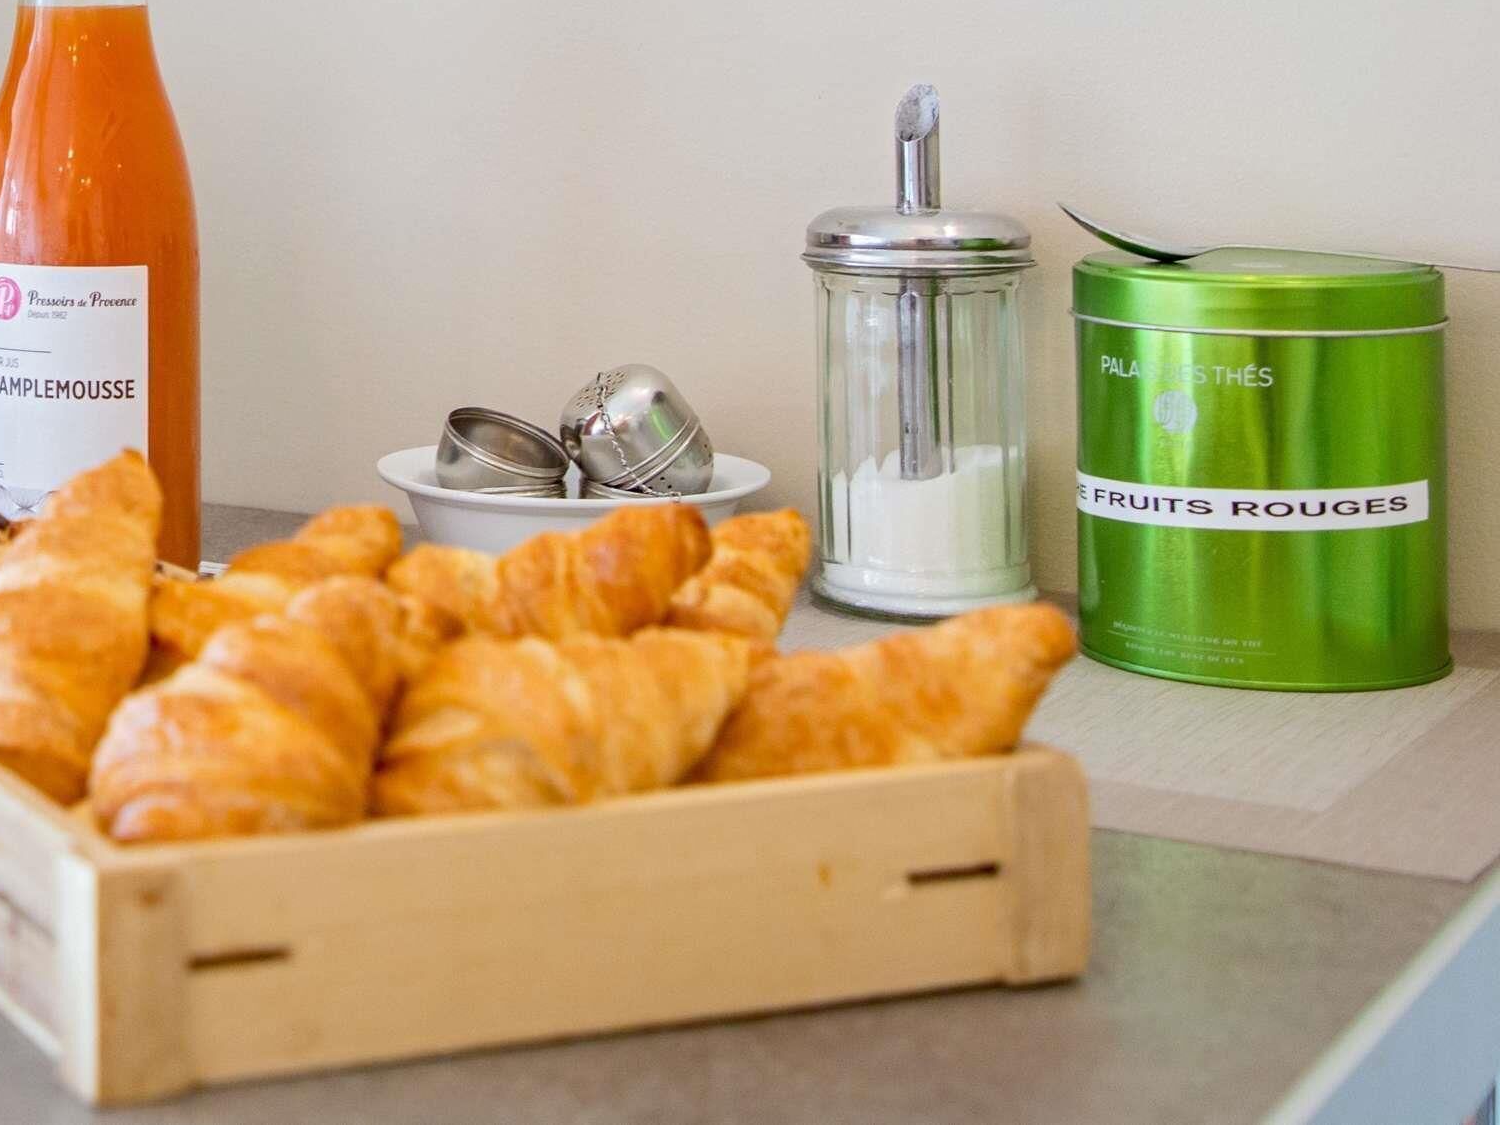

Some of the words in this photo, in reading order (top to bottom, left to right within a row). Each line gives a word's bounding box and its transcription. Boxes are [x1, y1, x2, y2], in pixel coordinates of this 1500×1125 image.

[27, 289, 75, 307] Pressoirs
[77, 298, 88, 307] de
[89, 290, 138, 308] Provence
[1212, 363, 1274, 387] THÉS
[1094, 487, 1214, 515] FRUITS
[1231, 495, 1409, 518] ROUGES
